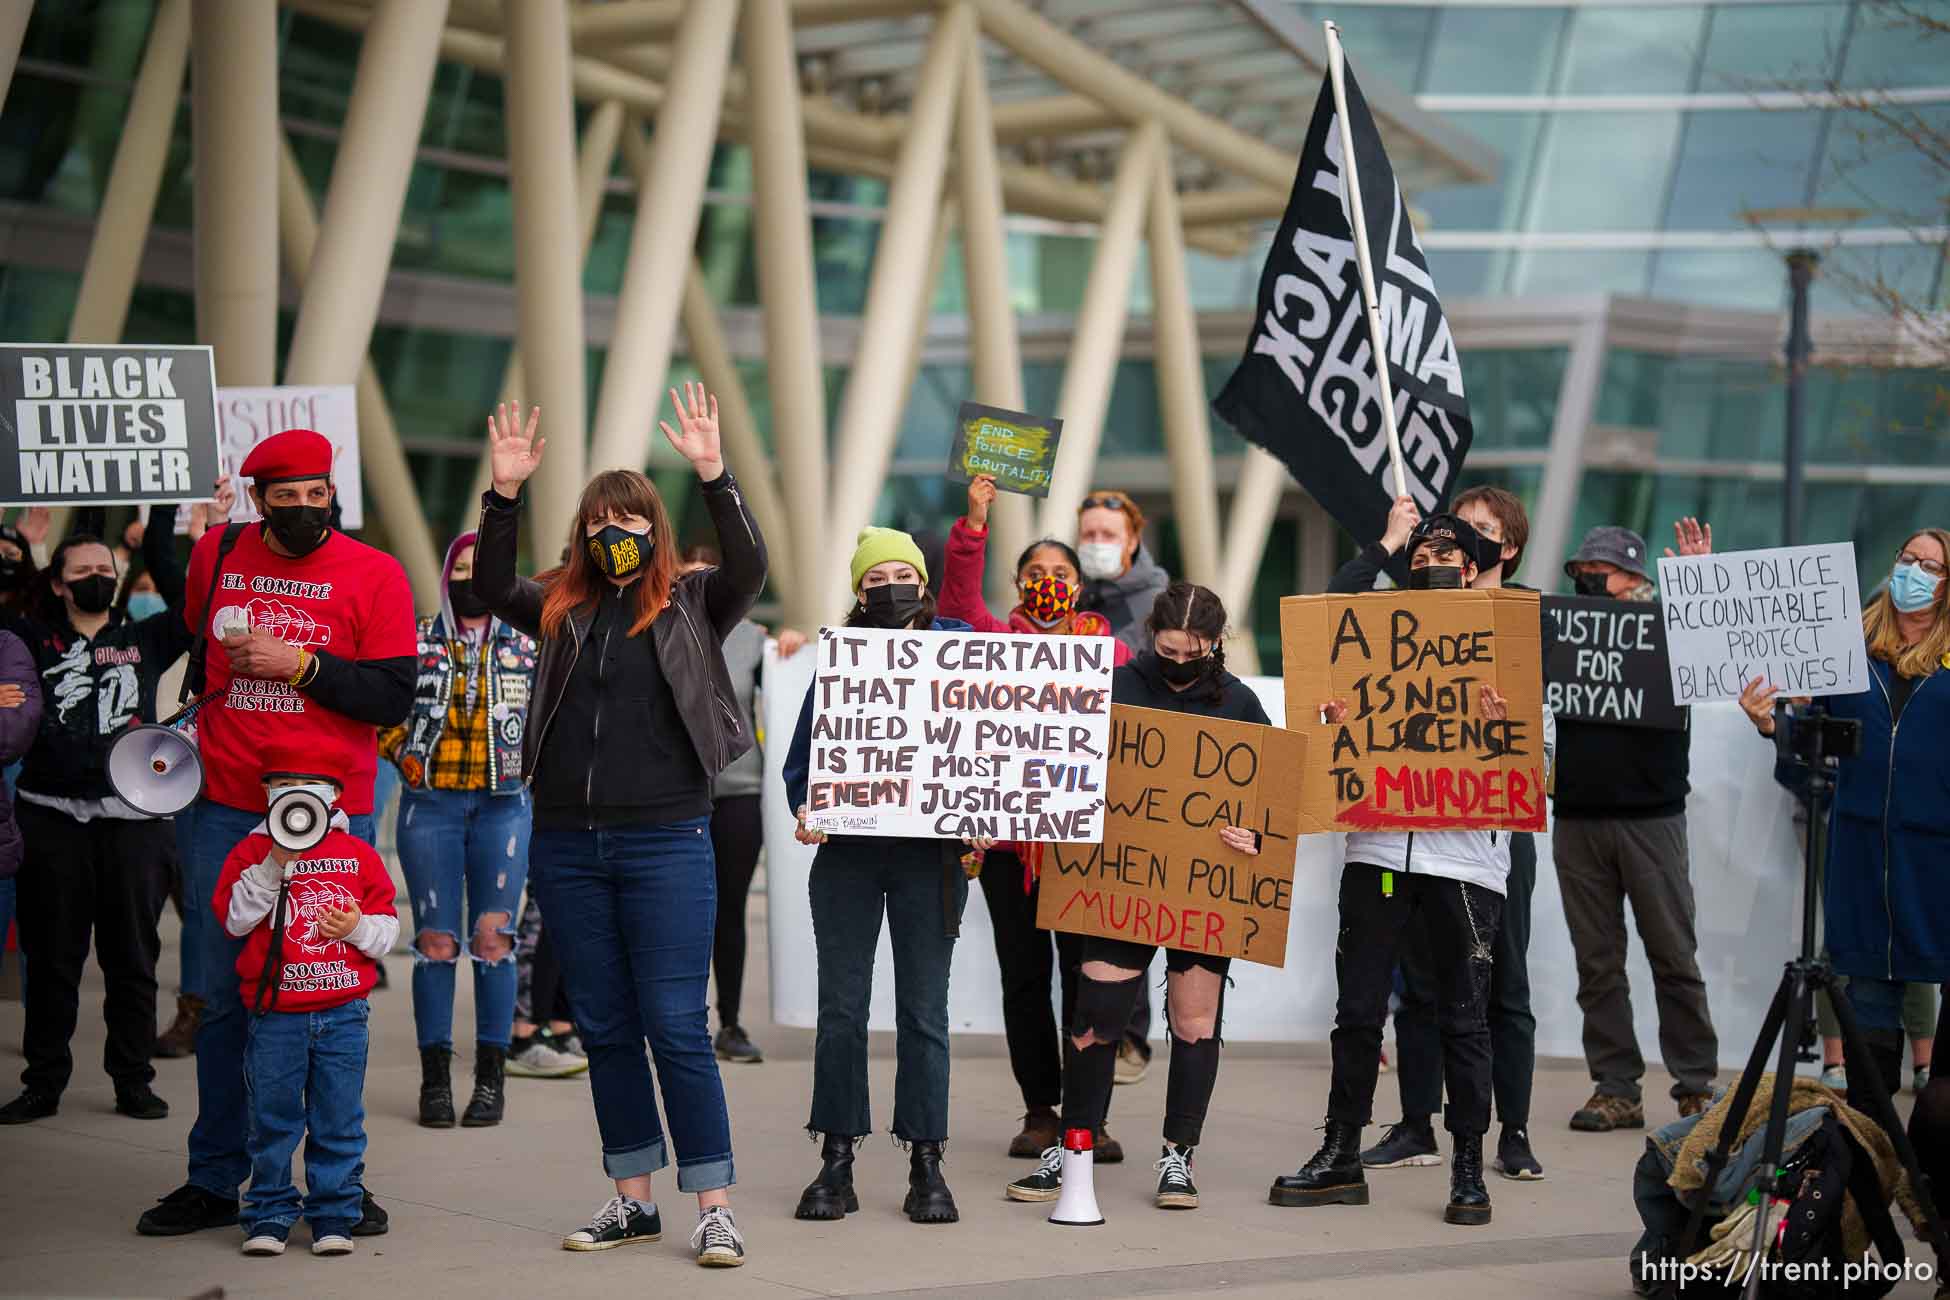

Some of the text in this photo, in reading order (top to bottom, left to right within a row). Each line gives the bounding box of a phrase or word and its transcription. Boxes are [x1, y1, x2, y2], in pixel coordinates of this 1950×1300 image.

[22, 357, 176, 398] BLACK
[38, 404, 166, 444] LIVES
[980, 424, 1014, 438] END
[976, 436, 1034, 461] POLICE
[19, 450, 191, 494] MATTER
[610, 536, 637, 556] BLACK
[614, 547, 639, 567] LIVES
[222, 573, 246, 590] EL
[1664, 555, 1839, 597] HOLD POLICE
[1331, 607, 1371, 664] A
[1727, 625, 1825, 660] PROTECT
[887, 638, 922, 670] IS
[1576, 649, 1624, 683] FOR
[231, 678, 299, 698] SOCIAL
[819, 675, 1109, 714] THAT IGNORANCE
[1353, 673, 1480, 720] IS NOT
[1678, 663, 1750, 699] BLACK
[225, 693, 305, 713] JUSTICE
[1547, 681, 1643, 720] BRYAN
[924, 717, 961, 753] W/
[975, 719, 1103, 760] POWER,
[1333, 725, 1360, 762] A
[818, 745, 1098, 792] IS THE MOST EVIL
[1193, 730, 1257, 787] DO
[810, 778, 909, 811] ENEMY
[1328, 766, 1364, 801] TO
[934, 813, 998, 838] CAN
[1105, 787, 1289, 840] WE CALL
[1054, 842, 1293, 912] WHEN POLICE
[281, 972, 360, 993] JUSTICE
[284, 960, 351, 980] SOCIAL
